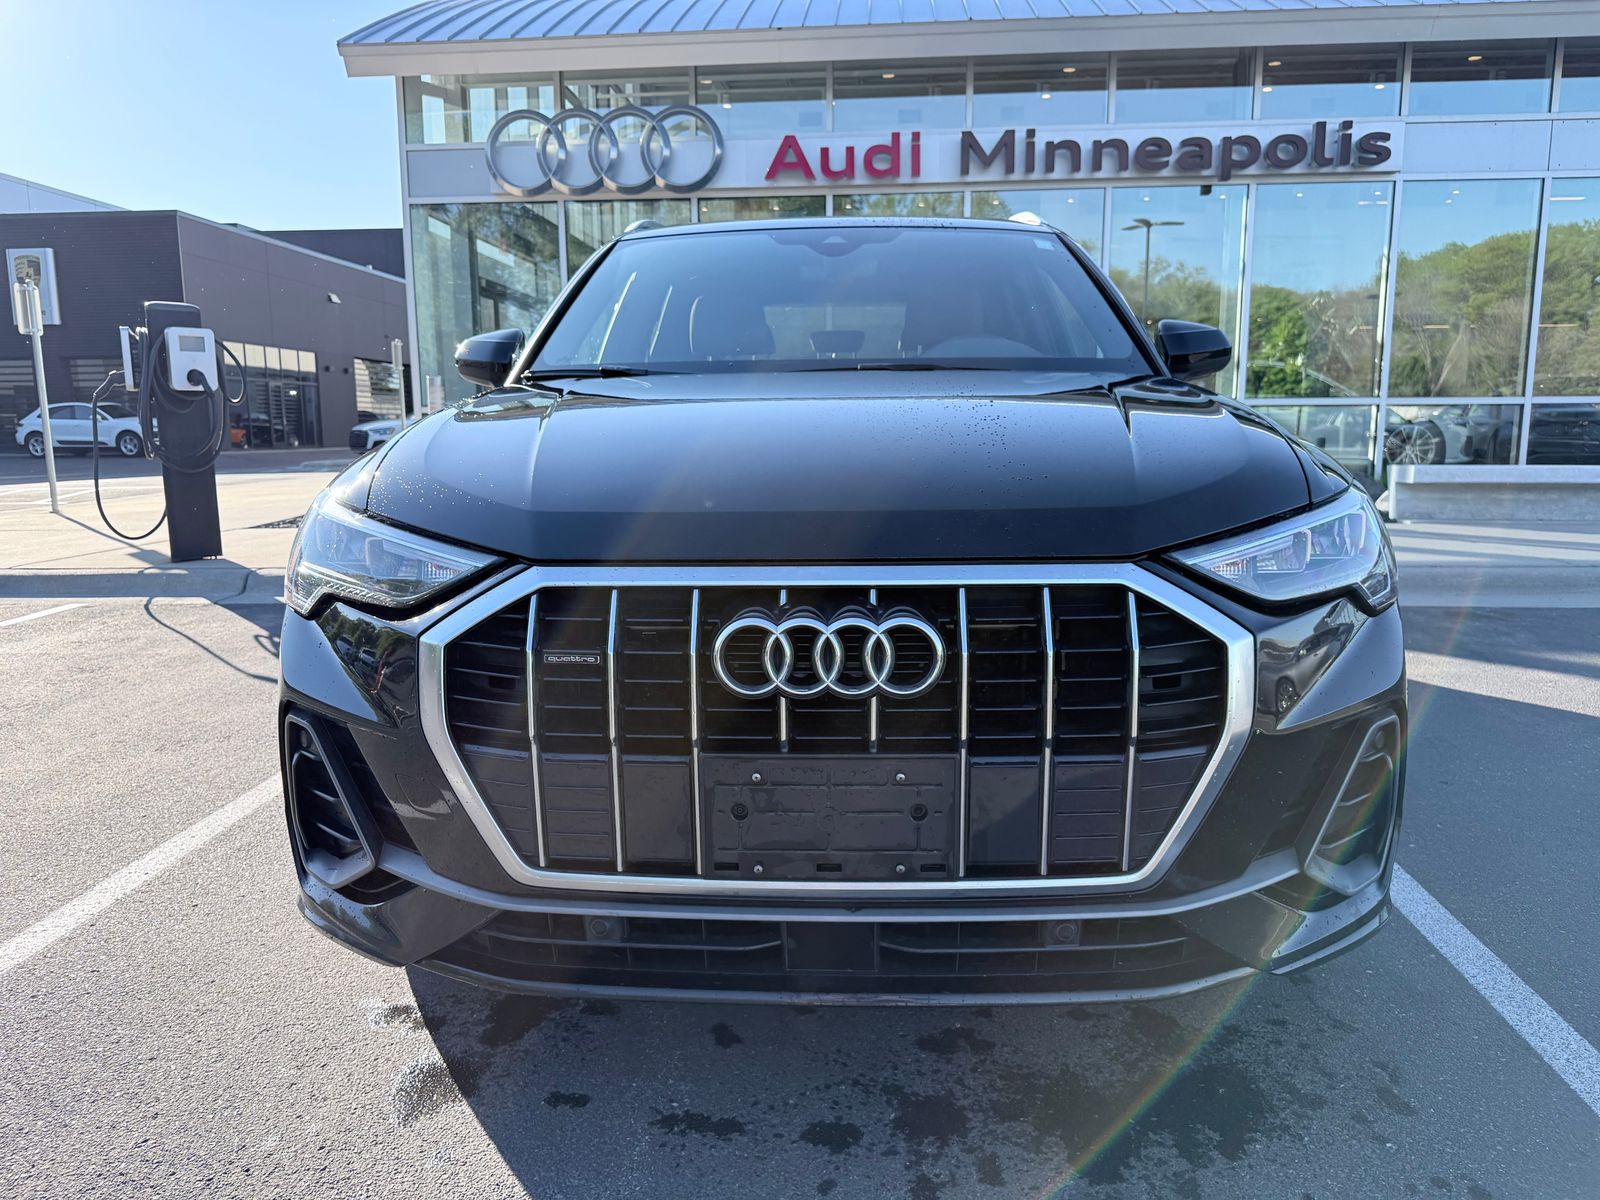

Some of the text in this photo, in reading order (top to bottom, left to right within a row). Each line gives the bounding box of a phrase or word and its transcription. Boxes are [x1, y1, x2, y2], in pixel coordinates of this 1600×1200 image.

[765, 120, 1392, 181] Audi Minneapolis
[547, 655, 596, 663] quattro
